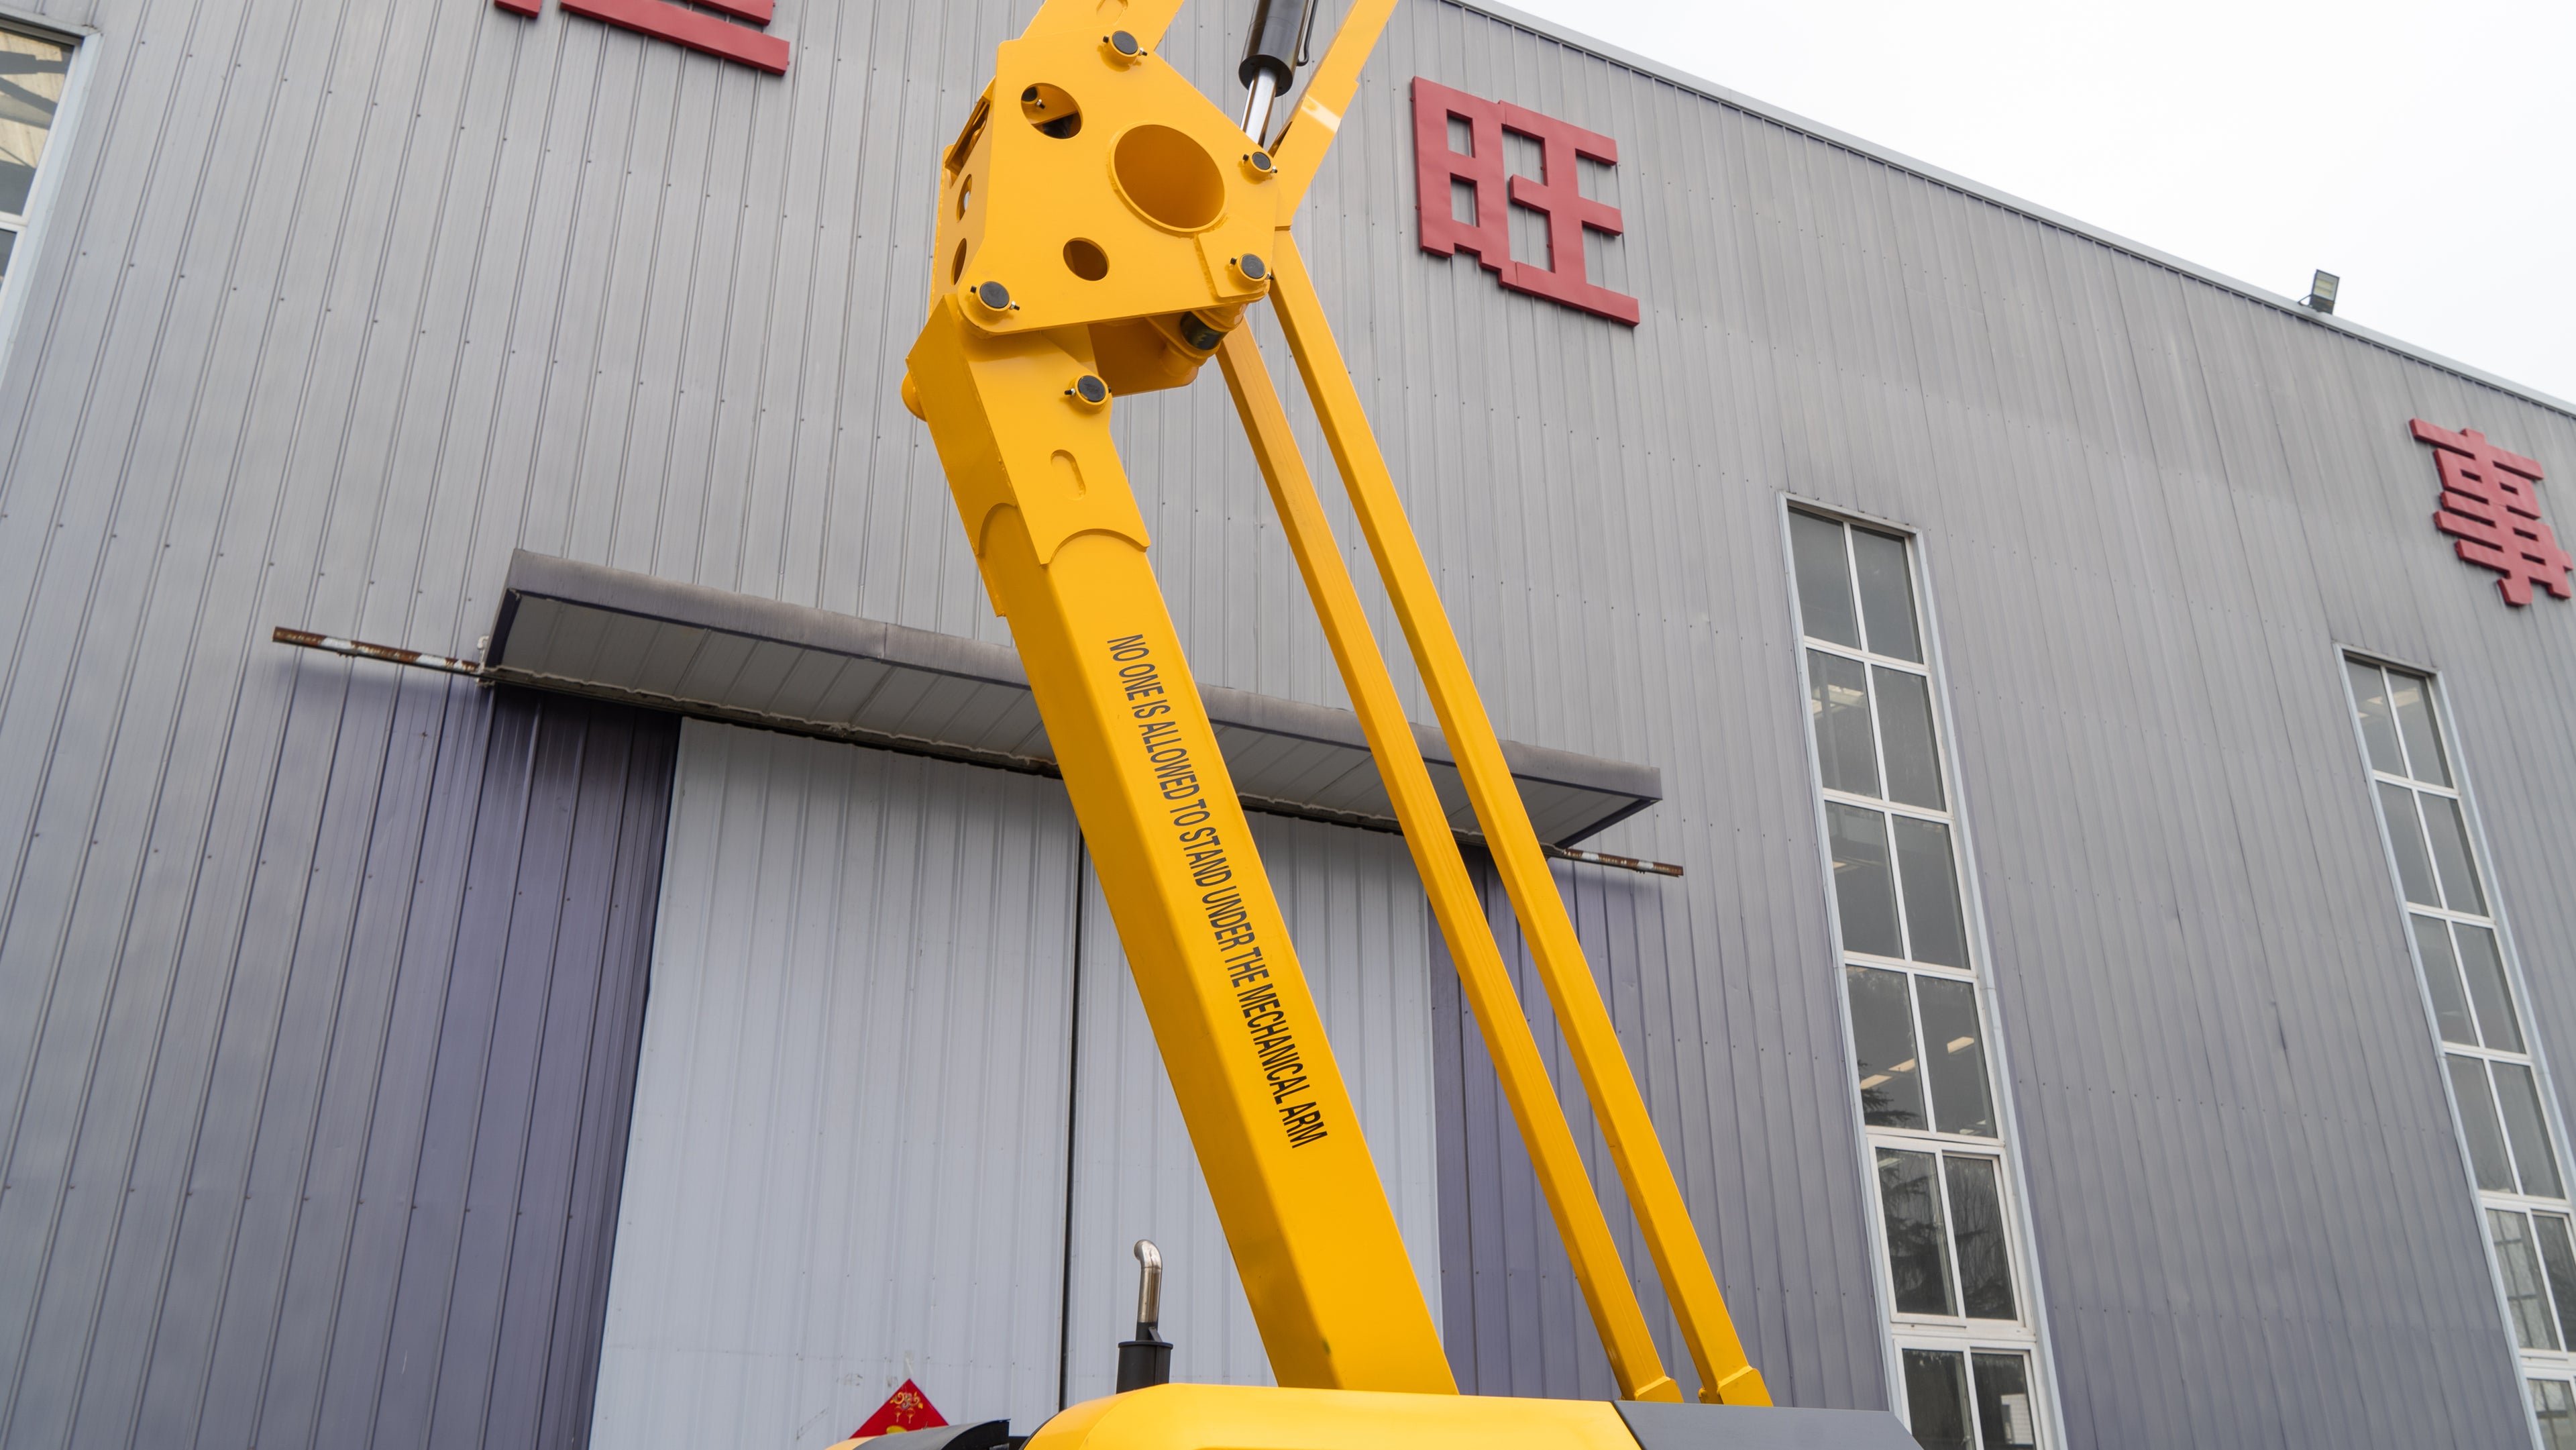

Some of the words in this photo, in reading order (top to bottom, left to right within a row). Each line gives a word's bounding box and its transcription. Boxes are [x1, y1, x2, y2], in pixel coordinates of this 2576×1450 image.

[1411, 76, 1640, 327] 旺
[2409, 417, 2574, 607] 事
[1107, 634, 1149, 662] NO
[1119, 663, 1164, 701] ONE
[1132, 699, 1171, 719] IS
[1138, 721, 1200, 800] ALLOWED
[1170, 798, 1210, 827] TO
[1179, 827, 1232, 887] STAND
[1202, 885, 1255, 952] UNDER
[1224, 946, 1270, 988] THE
[1237, 983, 1310, 1105] MECHANICAL
[1279, 1101, 1328, 1149] ARM
